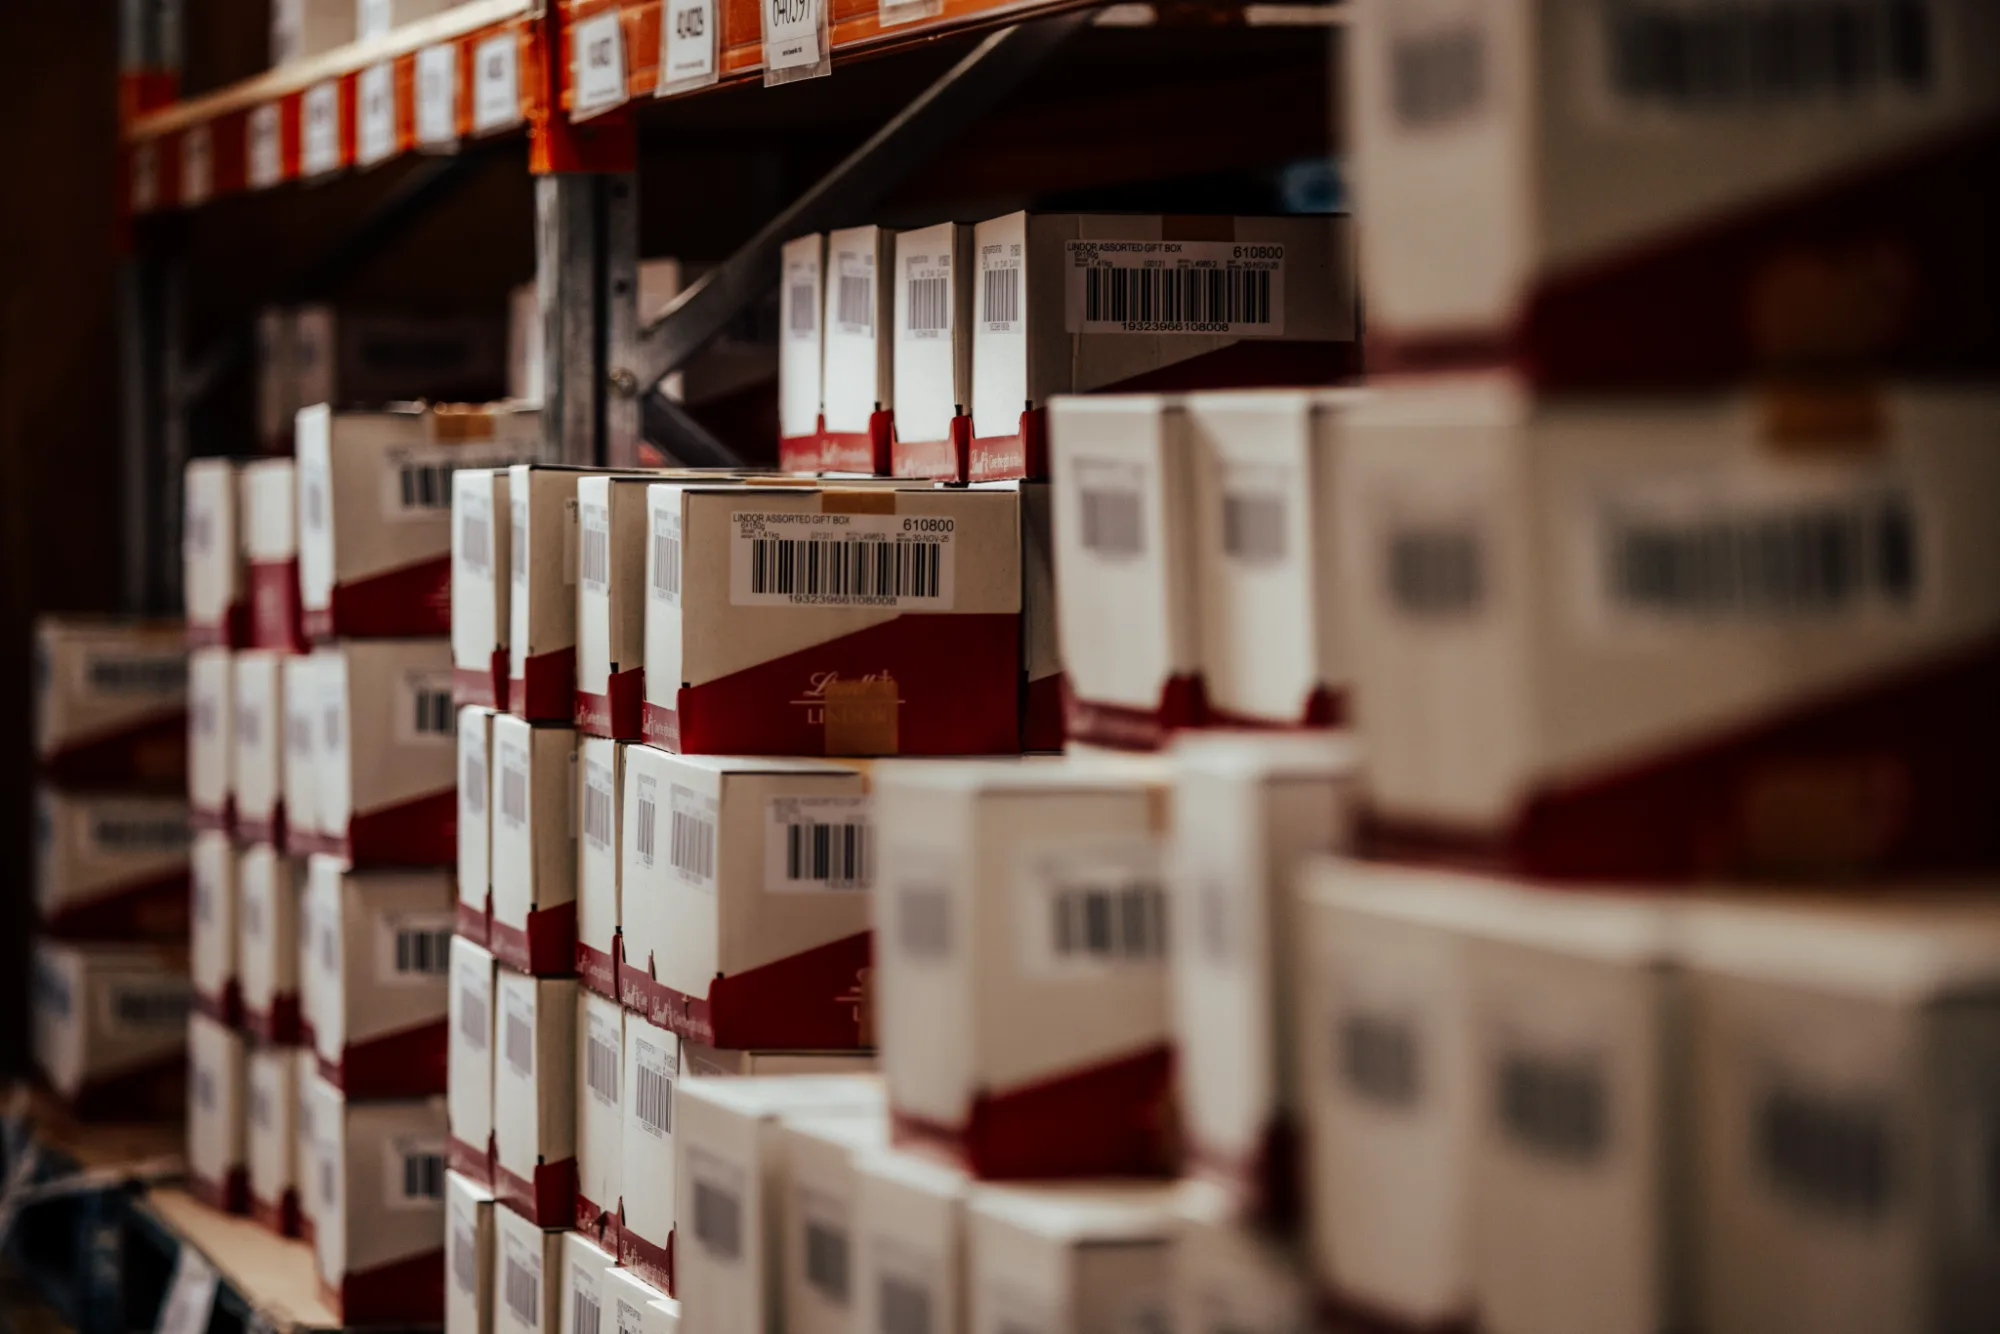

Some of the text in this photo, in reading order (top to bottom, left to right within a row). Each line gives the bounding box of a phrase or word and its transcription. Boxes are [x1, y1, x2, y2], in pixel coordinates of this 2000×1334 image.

[1067, 242, 1182, 253] LINDOR ASSORTED GIFT BOX
[1233, 246, 1283, 259] 610800
[1122, 322, 1229, 332] 19323966108008
[733, 513, 850, 525] LINDOR ASSORTED GIFT BOX
[903, 518, 954, 532] 610800
[788, 594, 897, 606] 19323966108008
